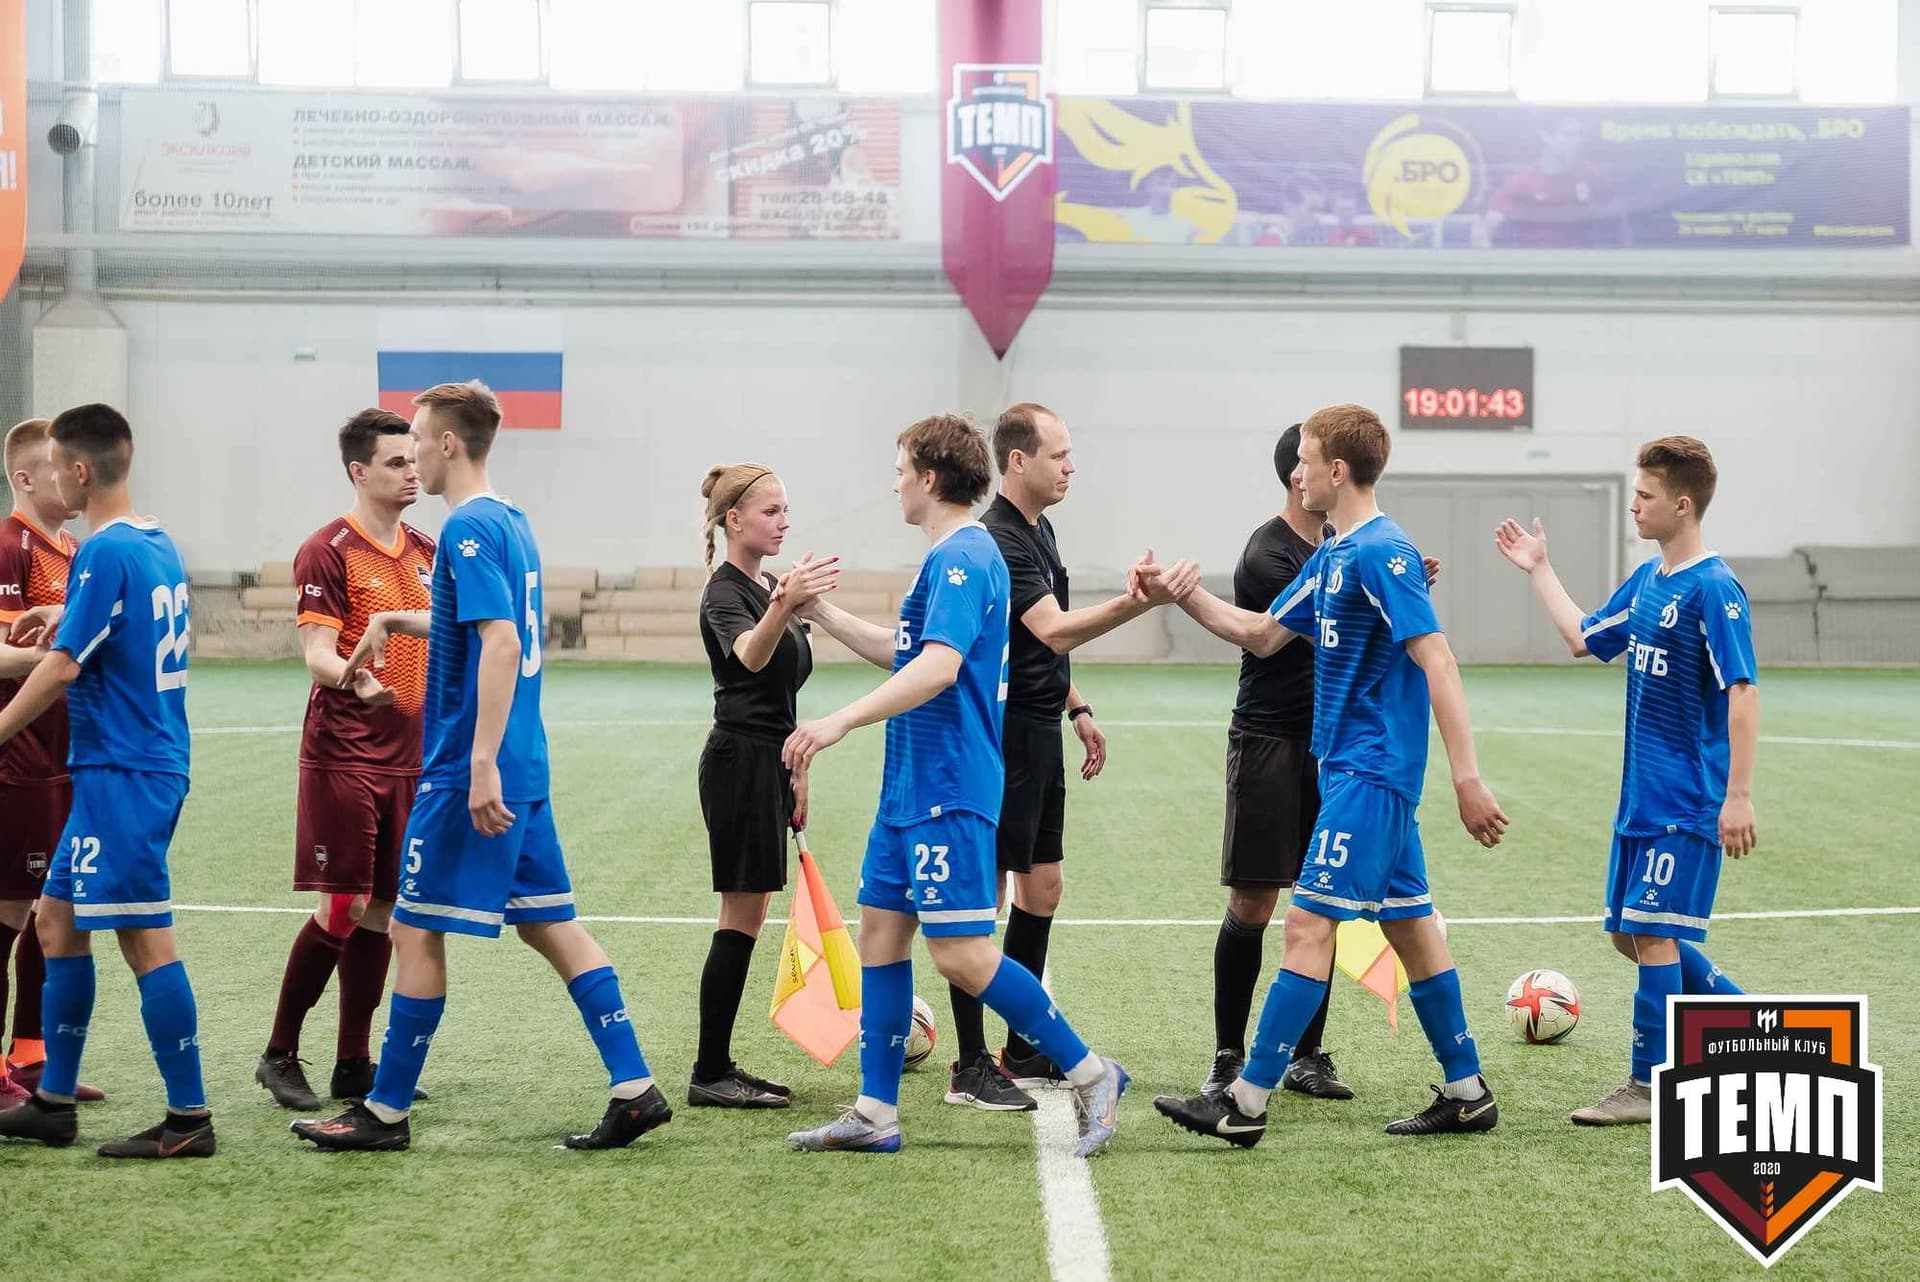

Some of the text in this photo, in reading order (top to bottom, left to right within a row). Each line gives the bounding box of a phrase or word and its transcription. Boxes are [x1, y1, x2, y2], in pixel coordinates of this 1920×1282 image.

[957, 102, 1043, 149] ТЕМП
[292, 153, 381, 170] ДЕТСКИЙ
[134, 190, 202, 209] более
[1404, 387, 1525, 418] 19:01:43
[521, 571, 542, 678] 5
[1635, 643, 1668, 677] ВТБ
[71, 836, 101, 874] 22
[405, 837, 424, 874] 5
[914, 843, 950, 882] 23
[1314, 829, 1353, 868] 15
[1642, 848, 1675, 886] 10
